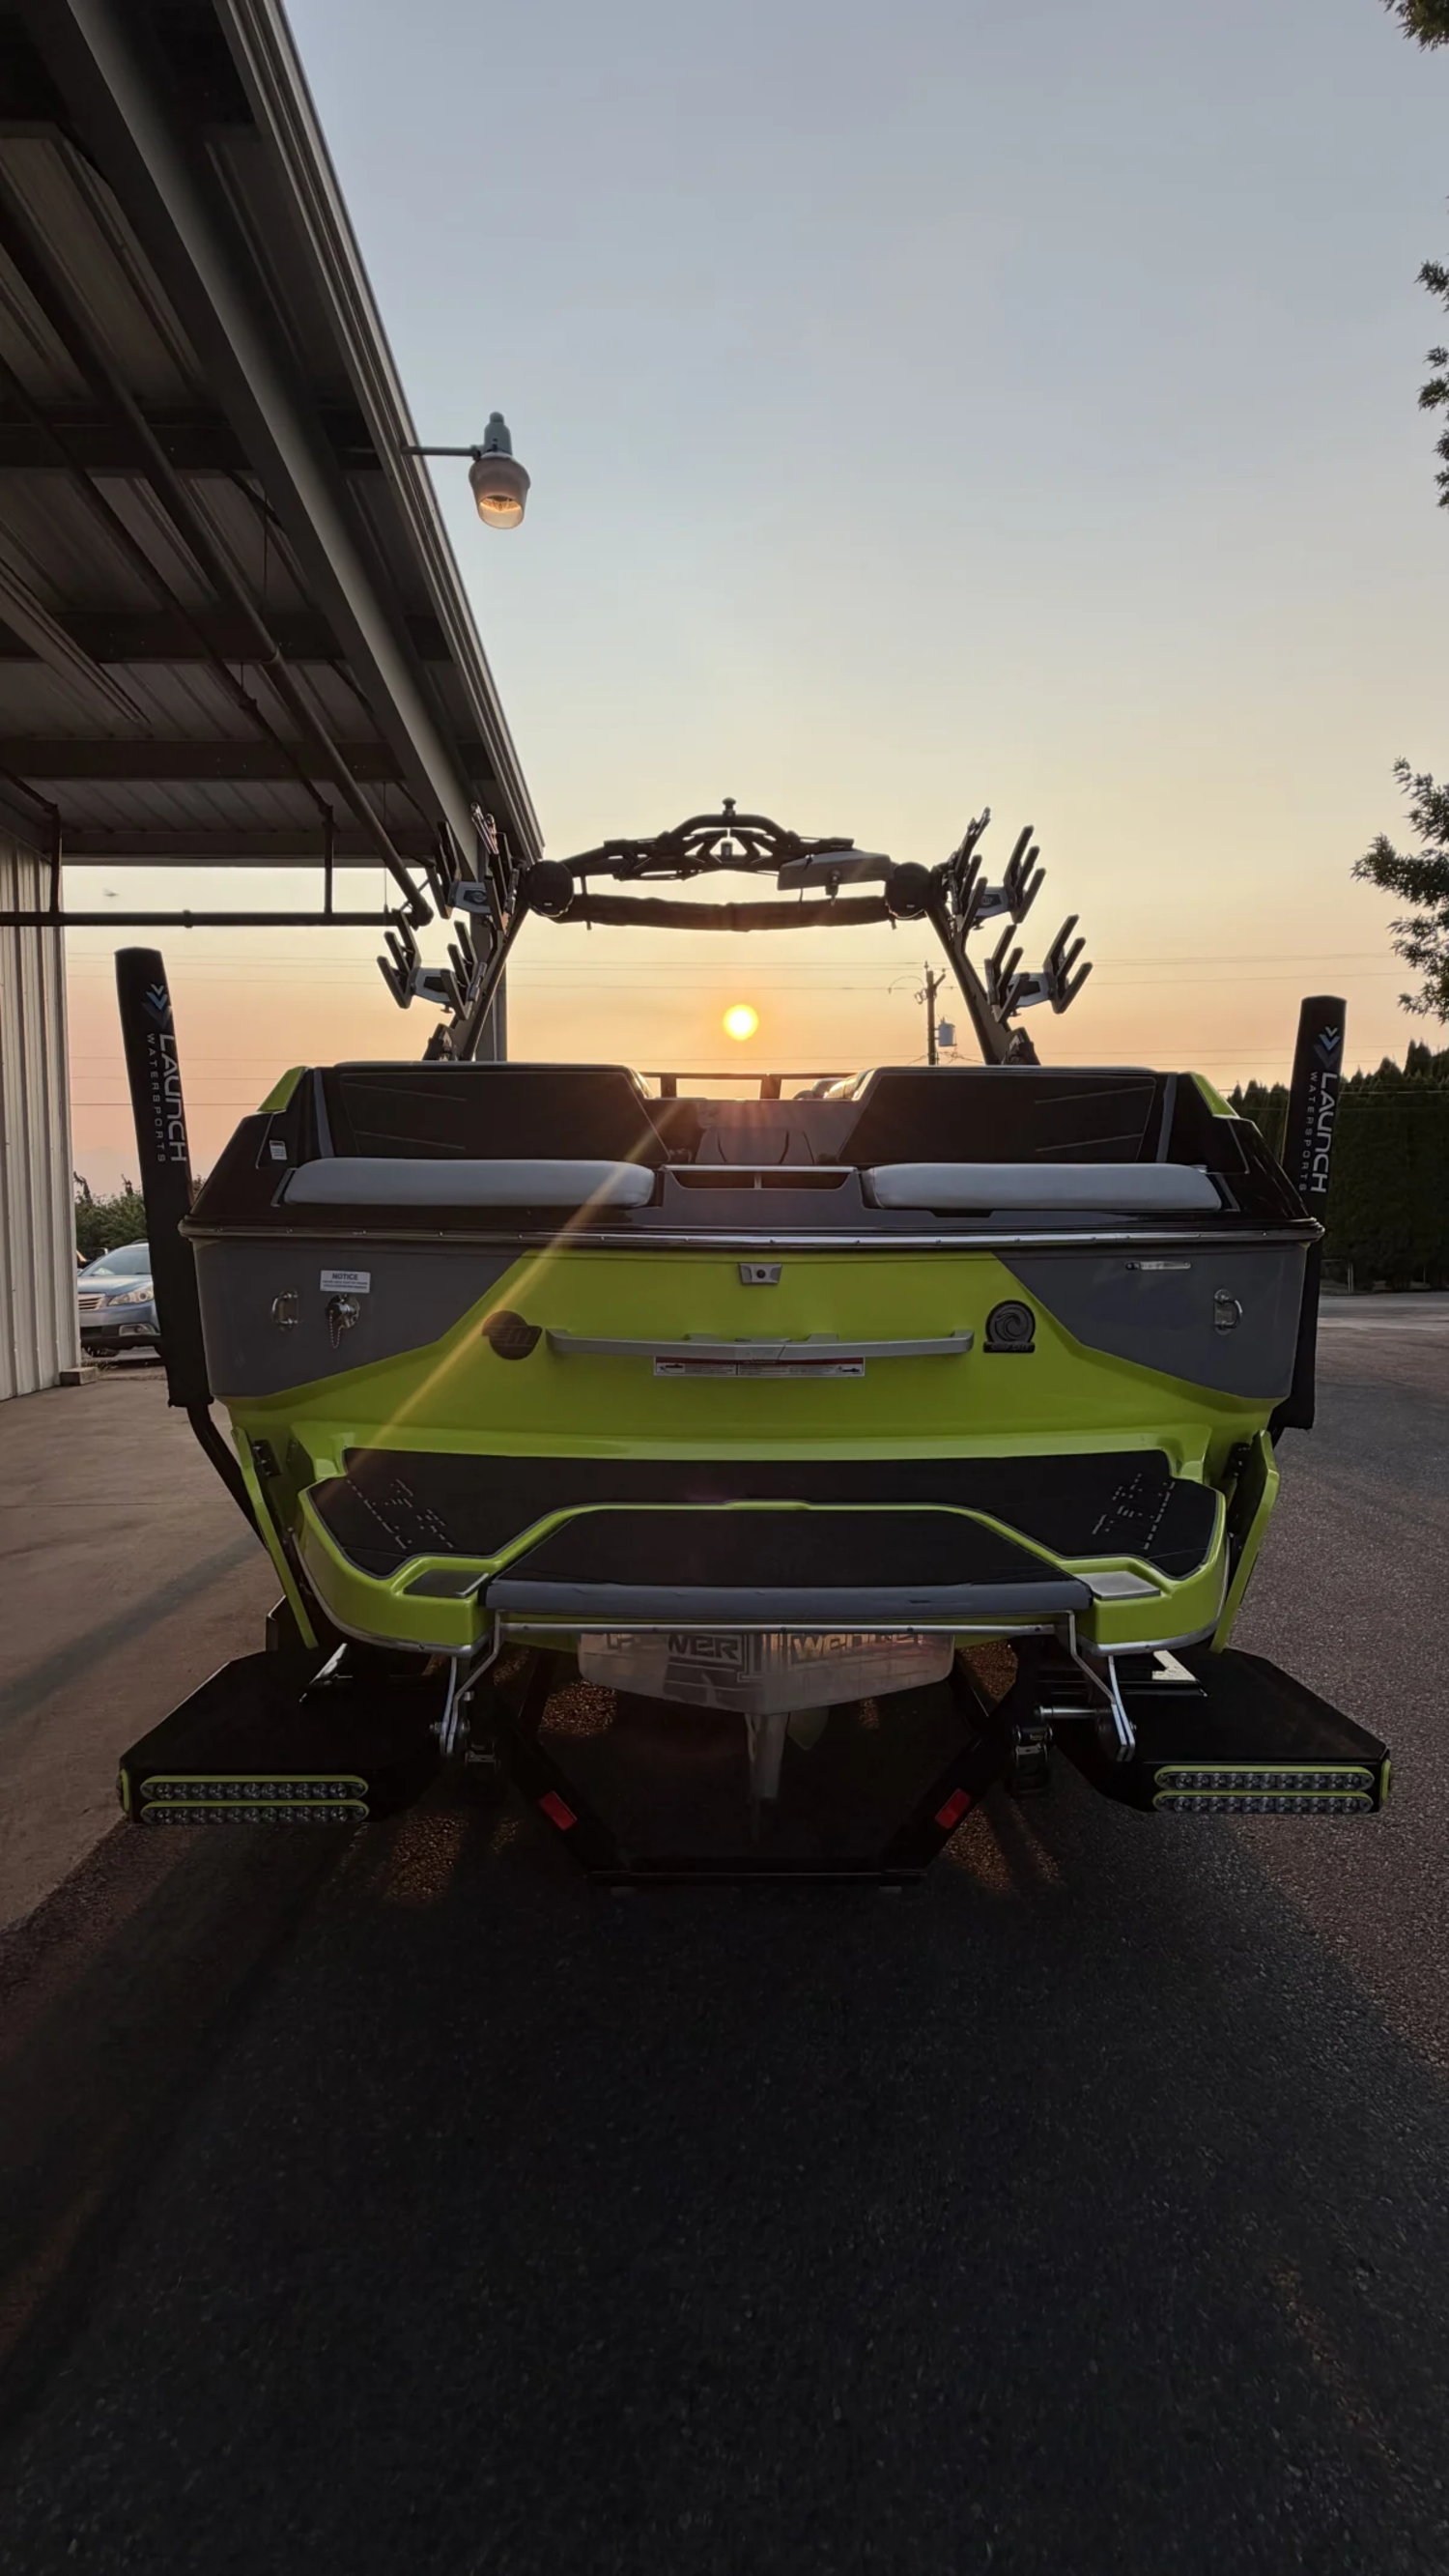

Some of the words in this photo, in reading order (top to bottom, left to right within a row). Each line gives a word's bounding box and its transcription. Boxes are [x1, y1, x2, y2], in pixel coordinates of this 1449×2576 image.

[147, 1033, 166, 1162] WATERSPORTS
[159, 1033, 187, 1161] LAUNCH
[1298, 1072, 1319, 1191] WATERSPORTS
[1310, 1072, 1338, 1193] LAUNCH
[331, 1273, 359, 1281] NOTICE
